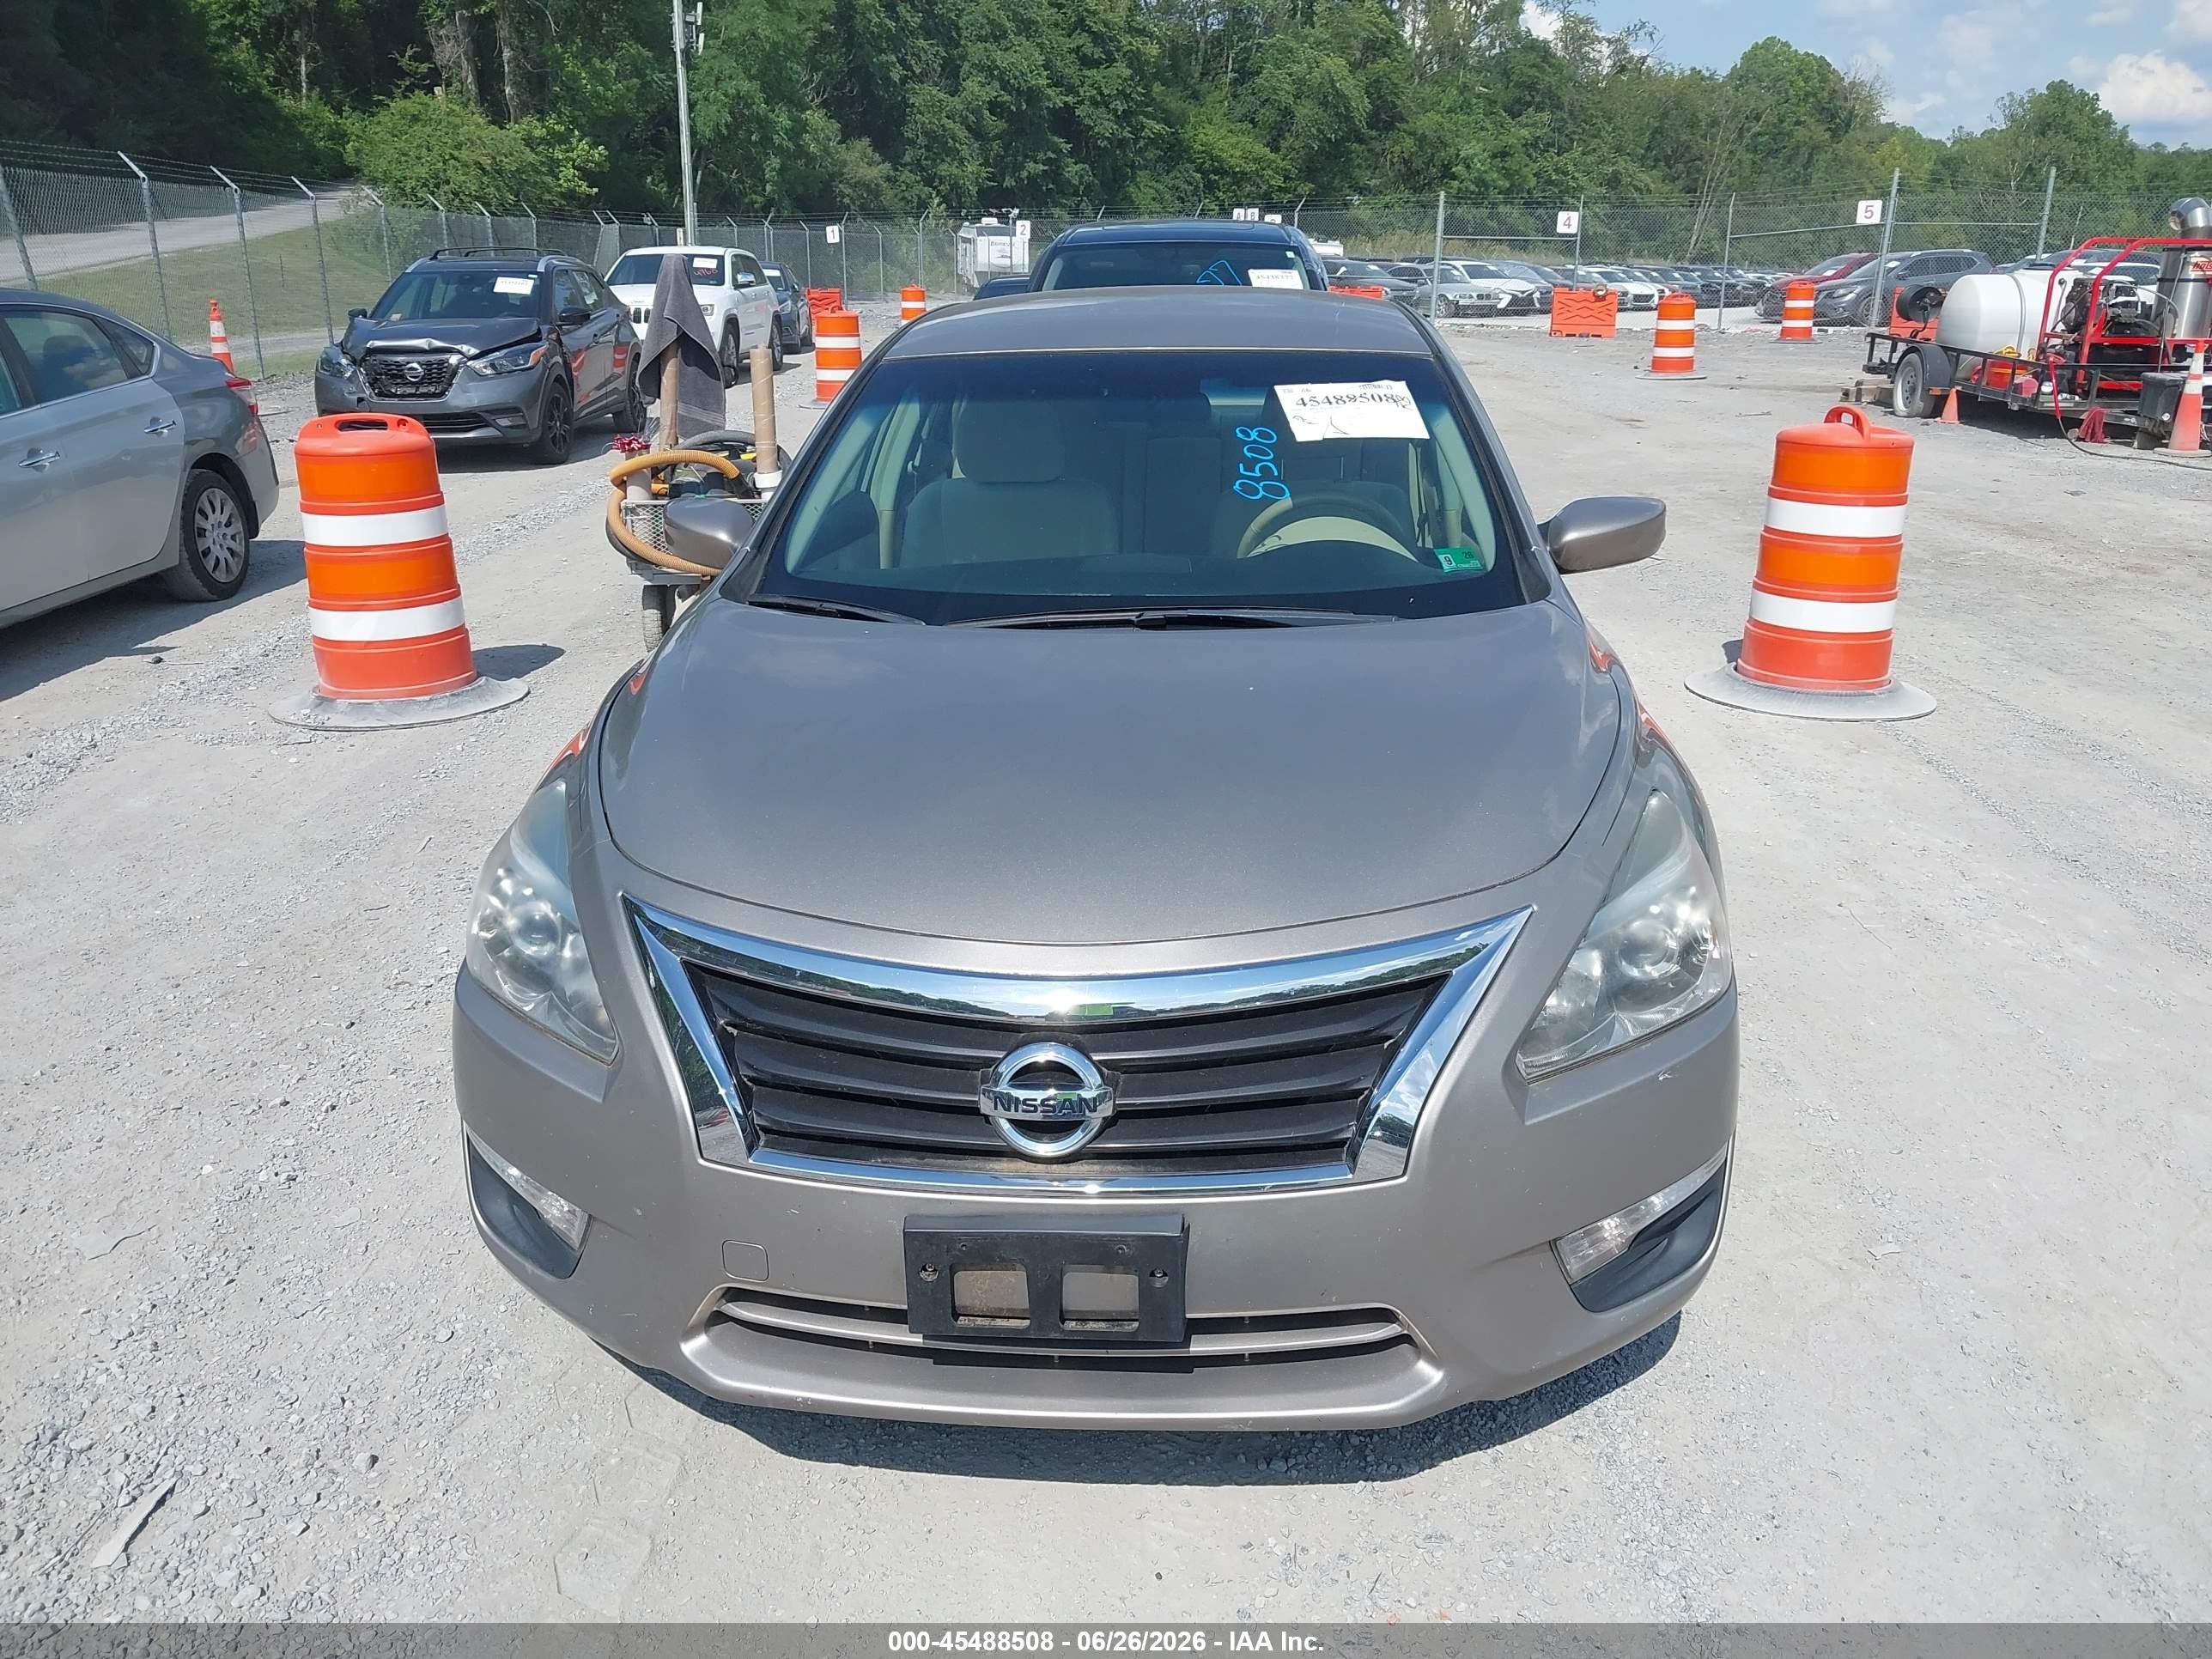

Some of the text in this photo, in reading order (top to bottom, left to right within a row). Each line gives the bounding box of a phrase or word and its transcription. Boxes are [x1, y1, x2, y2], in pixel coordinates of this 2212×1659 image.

[1863, 204, 1874, 219] 5
[1563, 216, 1572, 229] 4
[830, 227, 836, 240] 1
[1019, 224, 1026, 236] 2
[1233, 426, 1290, 500] 8508
[994, 1096, 1097, 1114] NISSAN
